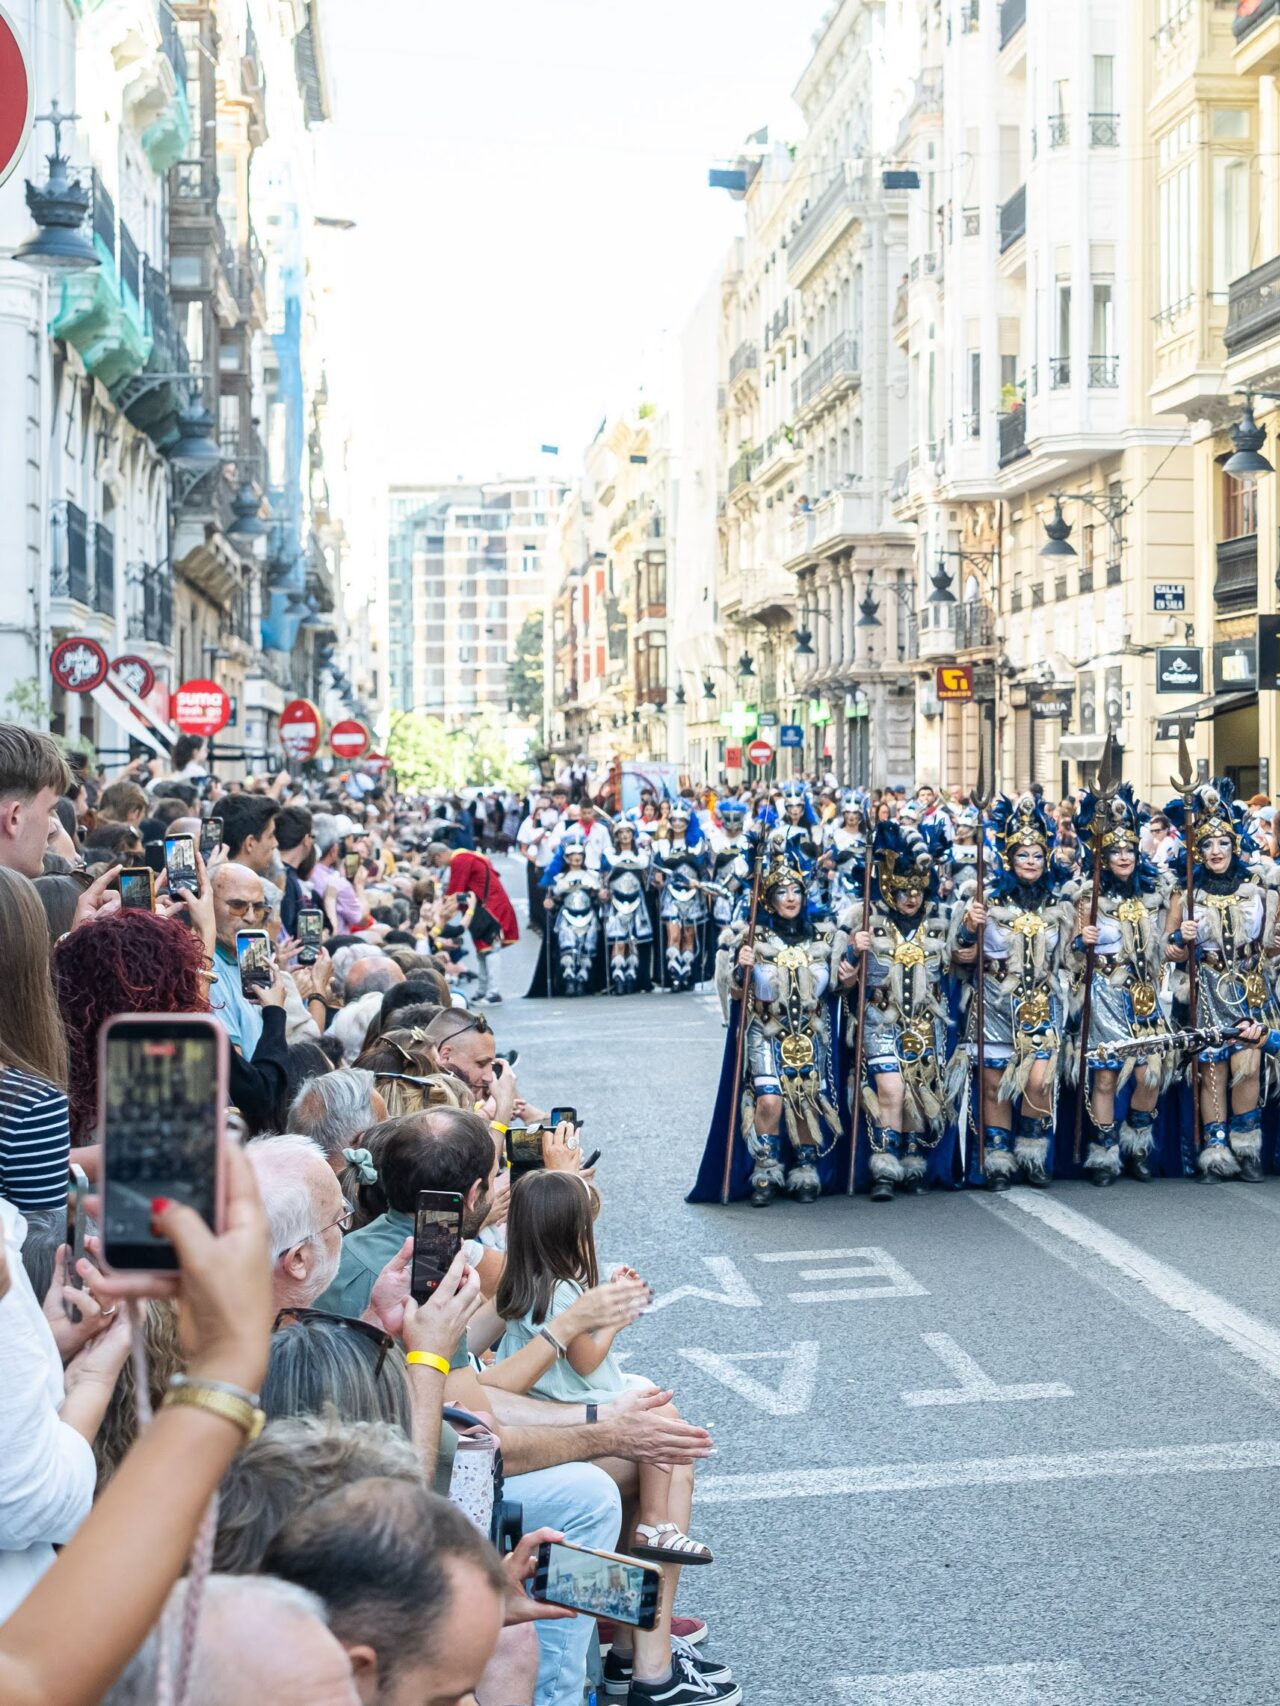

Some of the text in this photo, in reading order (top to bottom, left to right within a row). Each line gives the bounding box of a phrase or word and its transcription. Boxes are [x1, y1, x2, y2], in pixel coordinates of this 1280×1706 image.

[1155, 585, 1184, 594] CALLE
[938, 690, 972, 698] TABACOS
[177, 692, 222, 707] suma
[1035, 702, 1067, 713] TURIA
